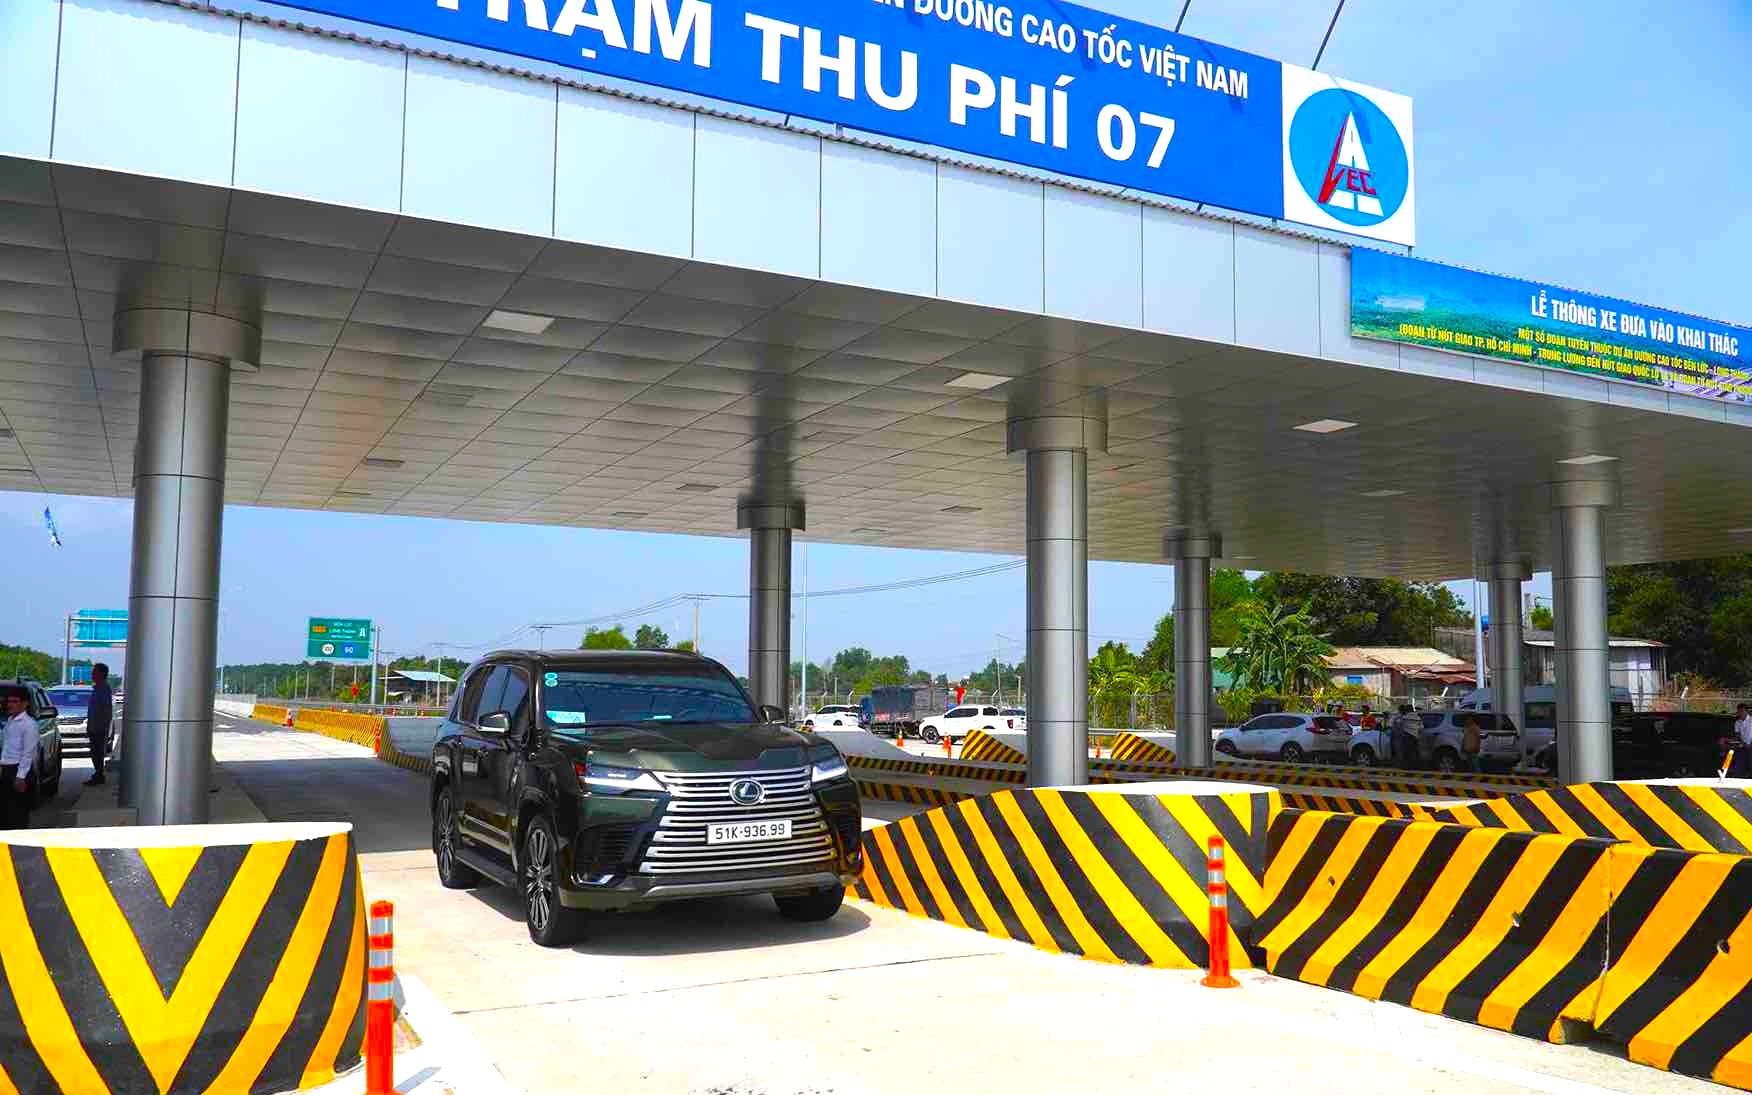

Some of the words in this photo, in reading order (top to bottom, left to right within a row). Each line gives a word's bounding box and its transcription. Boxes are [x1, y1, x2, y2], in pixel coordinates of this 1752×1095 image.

[1021, 13, 1077, 53] CAO
[1083, 24, 1132, 70] TỐC
[1139, 43, 1190, 88] VIỆT
[1196, 66, 1248, 100] NAM
[436, 0, 712, 68] ẠM
[745, 12, 918, 111] THU
[949, 63, 1076, 149] PHÍ
[1097, 103, 1176, 169] 07
[1455, 332, 1473, 346] GIAO
[1531, 289, 1548, 319] LỄ
[1550, 299, 1597, 328] THÔNG
[1600, 309, 1617, 332] XE
[1620, 313, 1647, 338] ĐƯA
[1650, 318, 1674, 344] VÀO
[1677, 325, 1706, 349] KHAI
[1708, 331, 1739, 357] THÁC
[1535, 330, 1545, 343] SỐ
[715, 823, 785, 839] 51K-936.99
